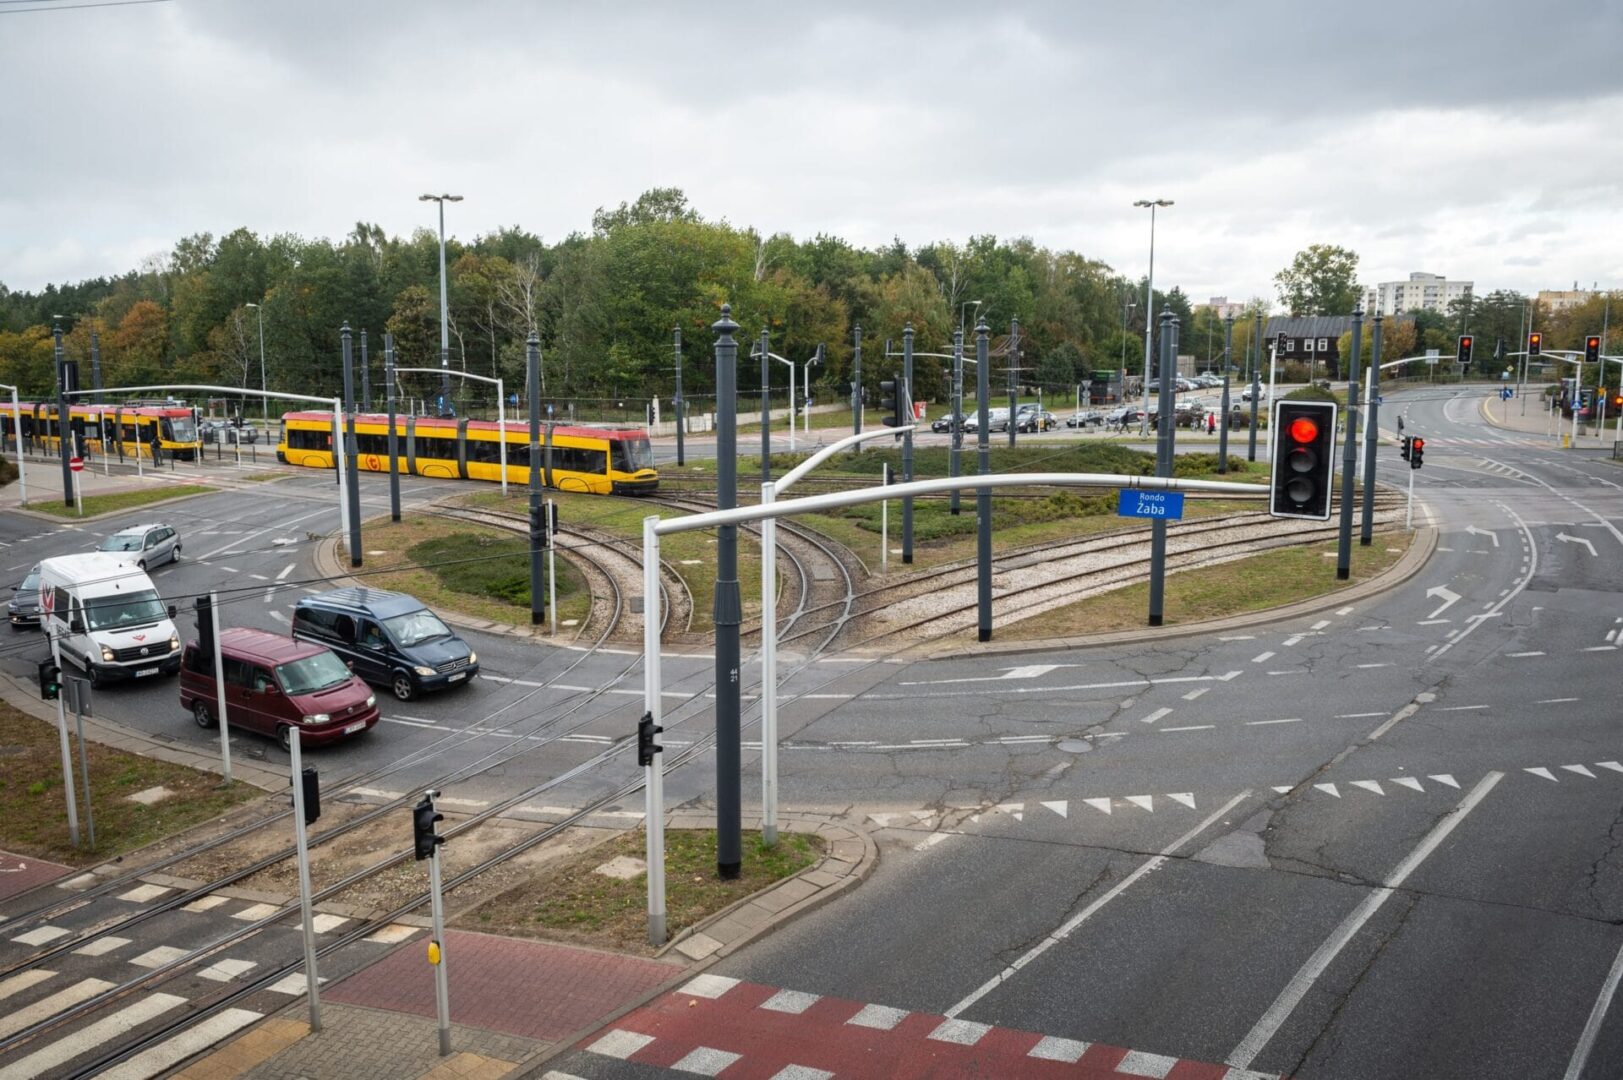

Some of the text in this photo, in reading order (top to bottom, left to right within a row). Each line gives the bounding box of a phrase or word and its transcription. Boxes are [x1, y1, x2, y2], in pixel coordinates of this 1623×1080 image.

[1139, 492, 1165, 502] Rondo
[1136, 500, 1165, 515] Żaba
[730, 675, 738, 683] 21
